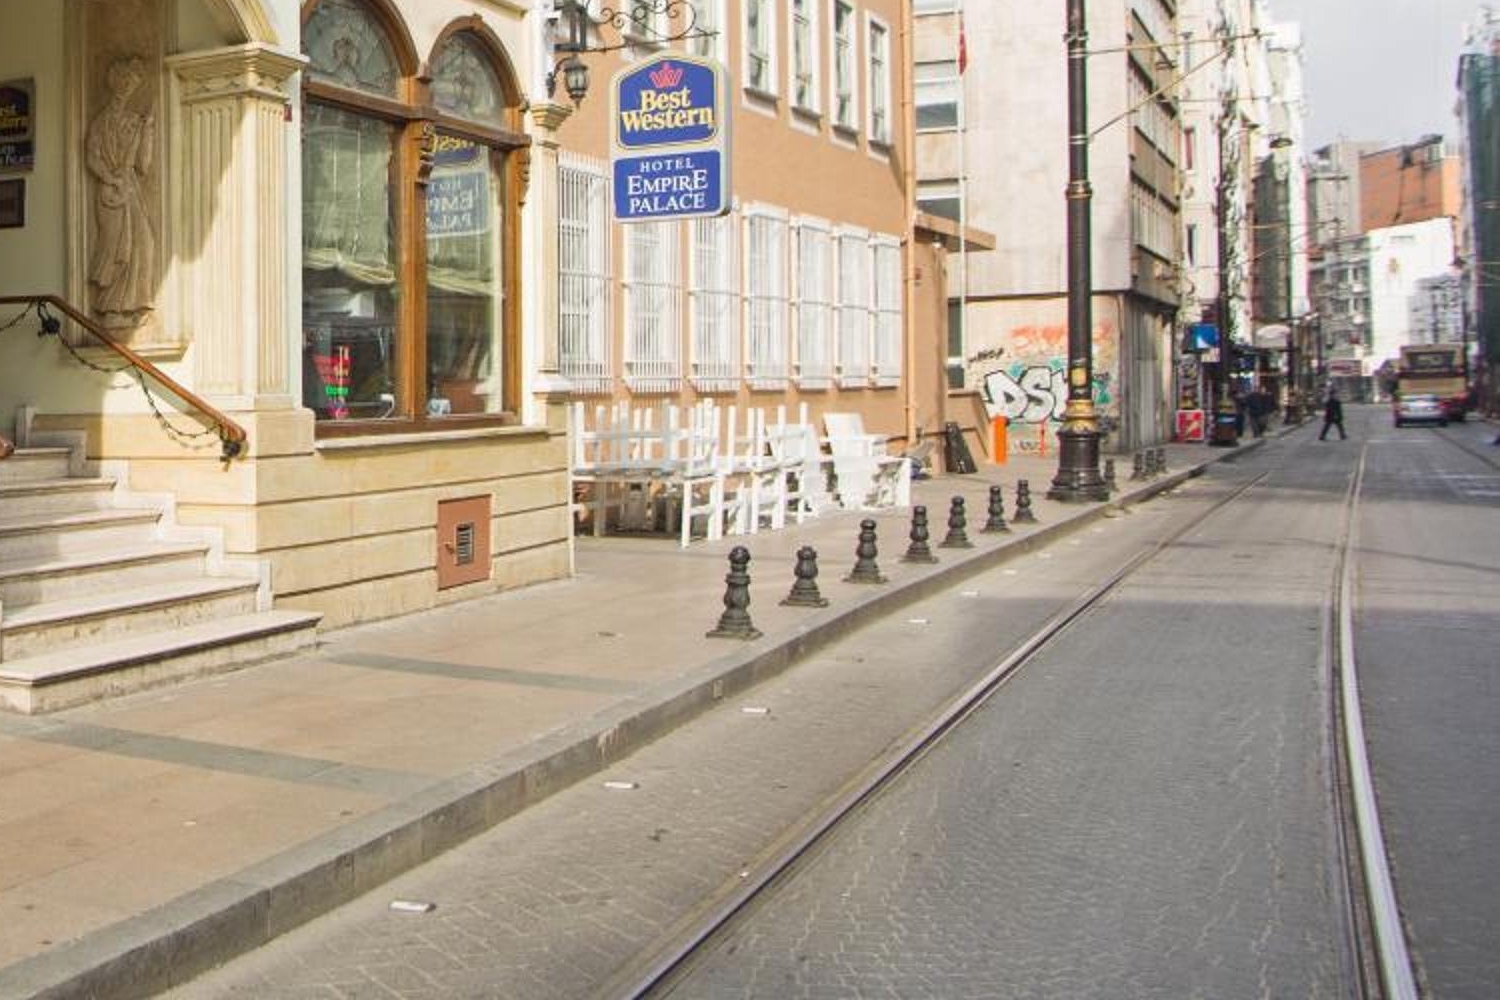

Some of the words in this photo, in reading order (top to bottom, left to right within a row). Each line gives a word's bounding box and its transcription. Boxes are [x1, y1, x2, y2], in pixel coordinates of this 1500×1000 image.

[639, 86, 692, 112] Best
[621, 106, 716, 133] Western
[640, 158, 695, 173] HOTEL
[627, 169, 709, 195] EMPIRE
[629, 191, 707, 215] PALACE
